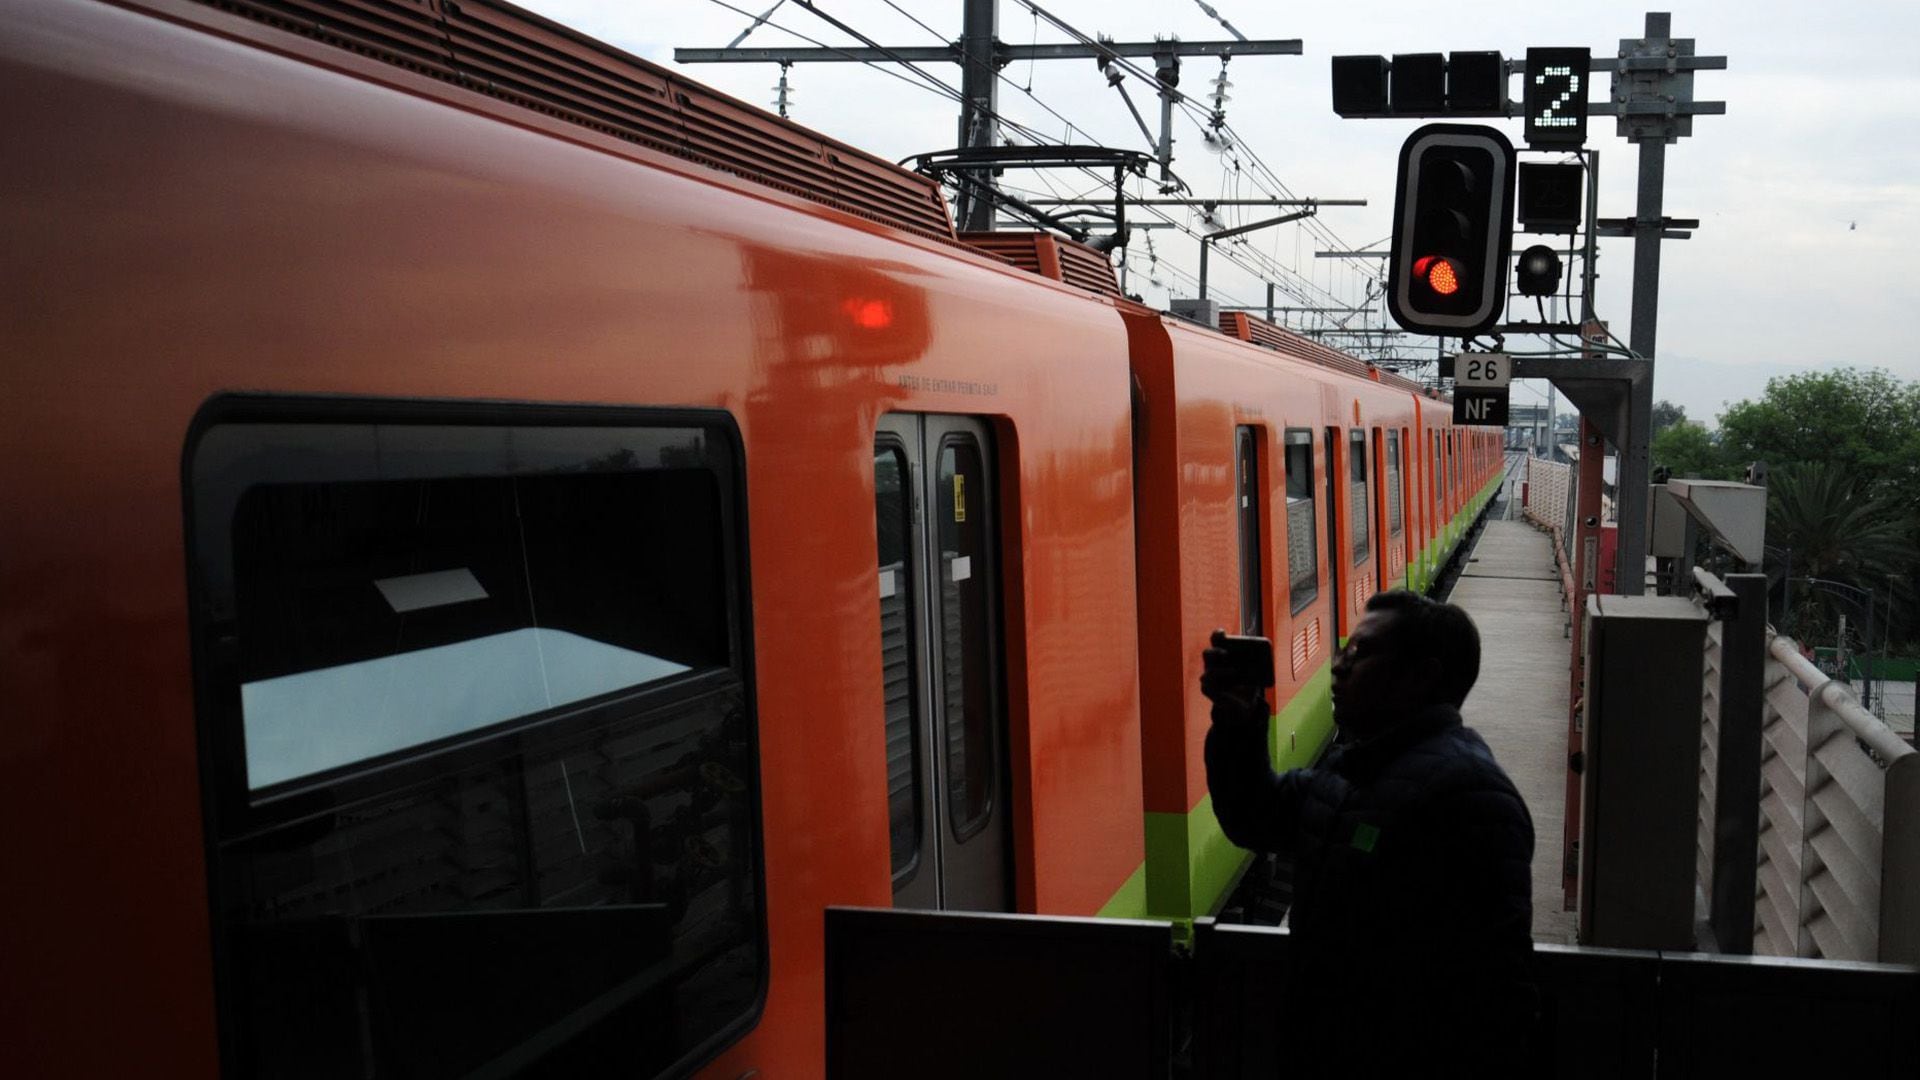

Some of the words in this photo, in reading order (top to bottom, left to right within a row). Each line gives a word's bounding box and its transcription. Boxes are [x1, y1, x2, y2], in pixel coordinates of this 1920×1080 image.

[1535, 66, 1578, 126] 2
[1467, 359, 1497, 381] 26
[922, 377, 931, 391] DE
[933, 378, 955, 393] ENTRAR
[957, 380, 981, 395] PERMITA
[1465, 398, 1497, 420] NF
